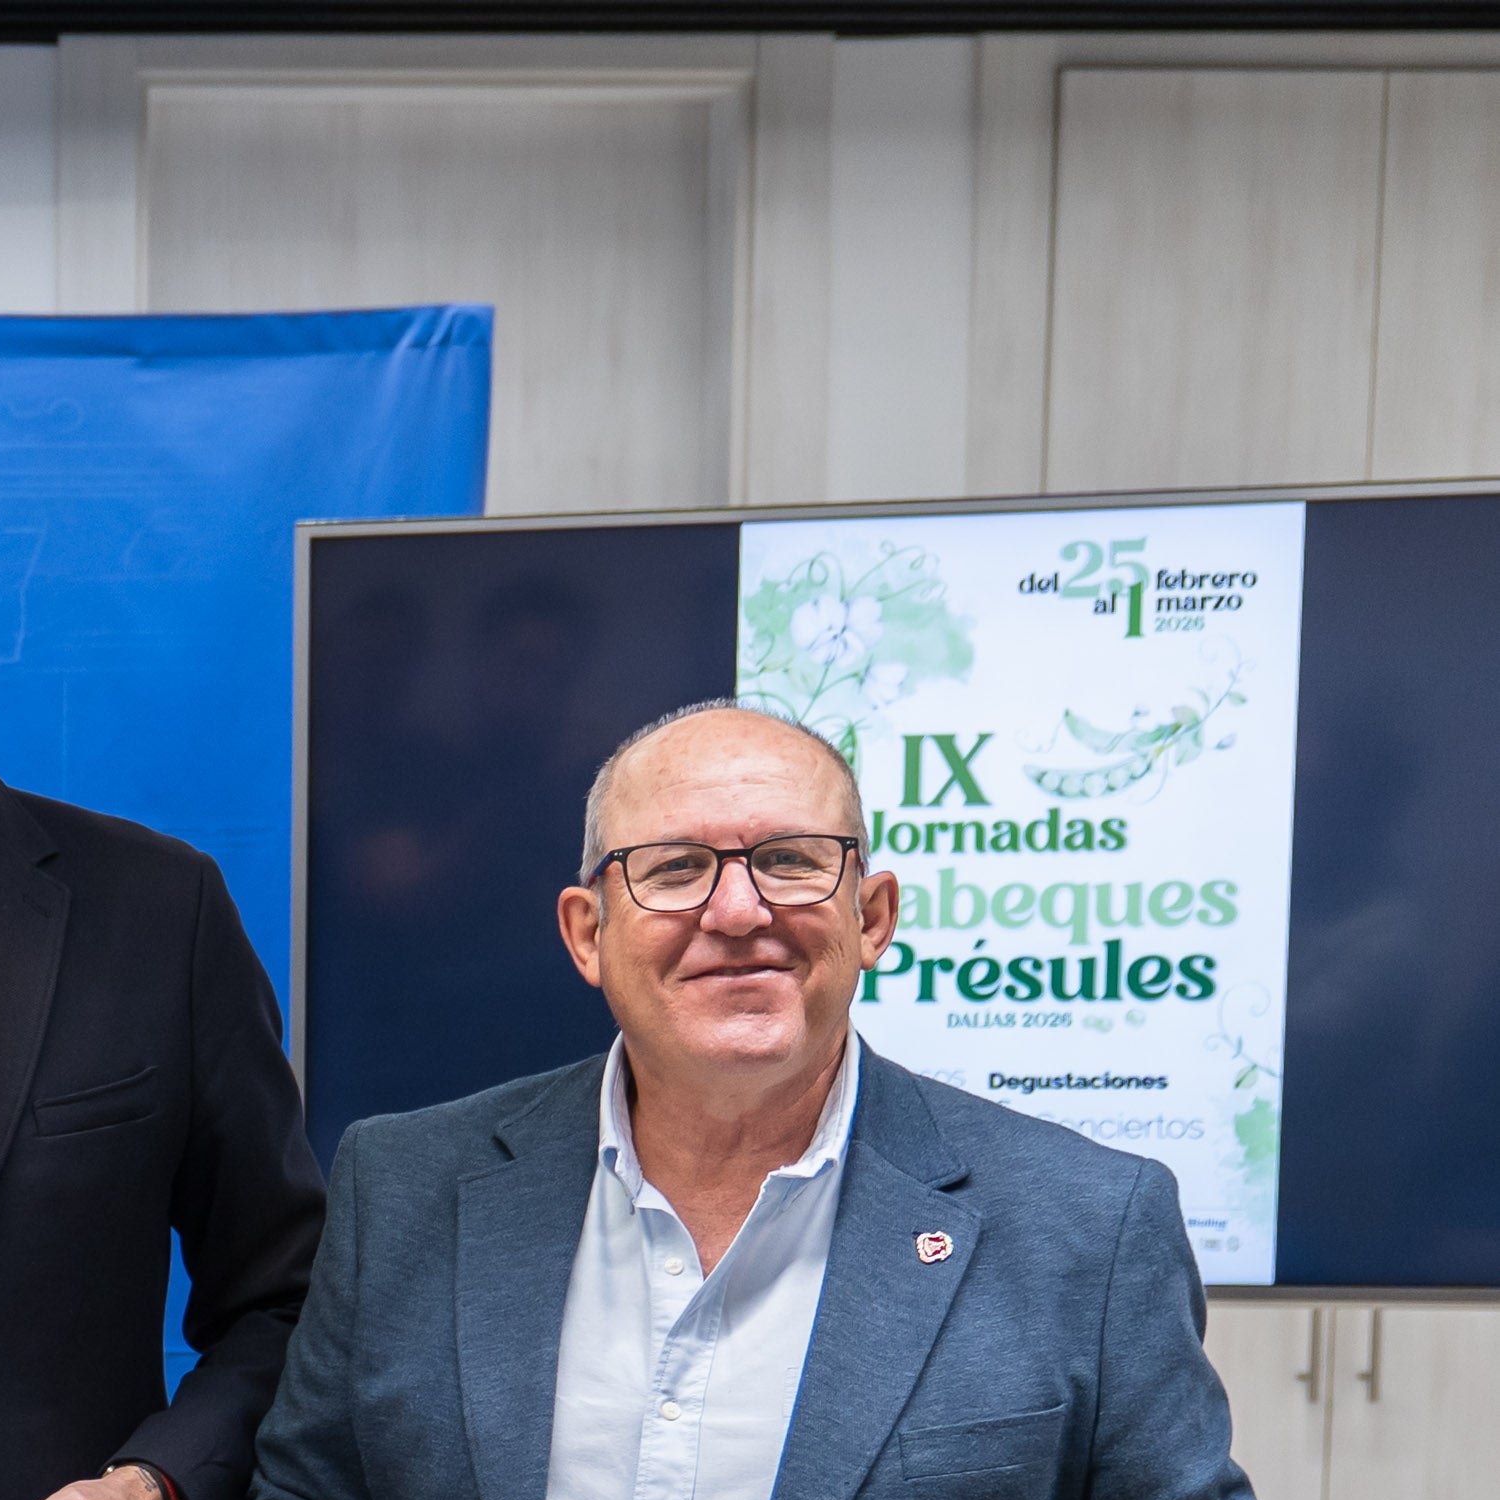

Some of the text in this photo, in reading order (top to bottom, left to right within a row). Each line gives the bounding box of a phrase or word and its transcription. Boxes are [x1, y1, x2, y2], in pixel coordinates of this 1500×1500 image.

[1018, 535, 1258, 599] del 25 febrero
[1093, 580, 1244, 639] al 1 marzo
[1153, 614, 1206, 633] 2026
[898, 732, 995, 807] IX
[869, 806, 1129, 855] Jornadas
[898, 866, 1240, 946] abeques
[859, 937, 1218, 1003] Présules
[1022, 1011, 1073, 1028] 2026
[988, 1071, 1170, 1095] Degustaciones
